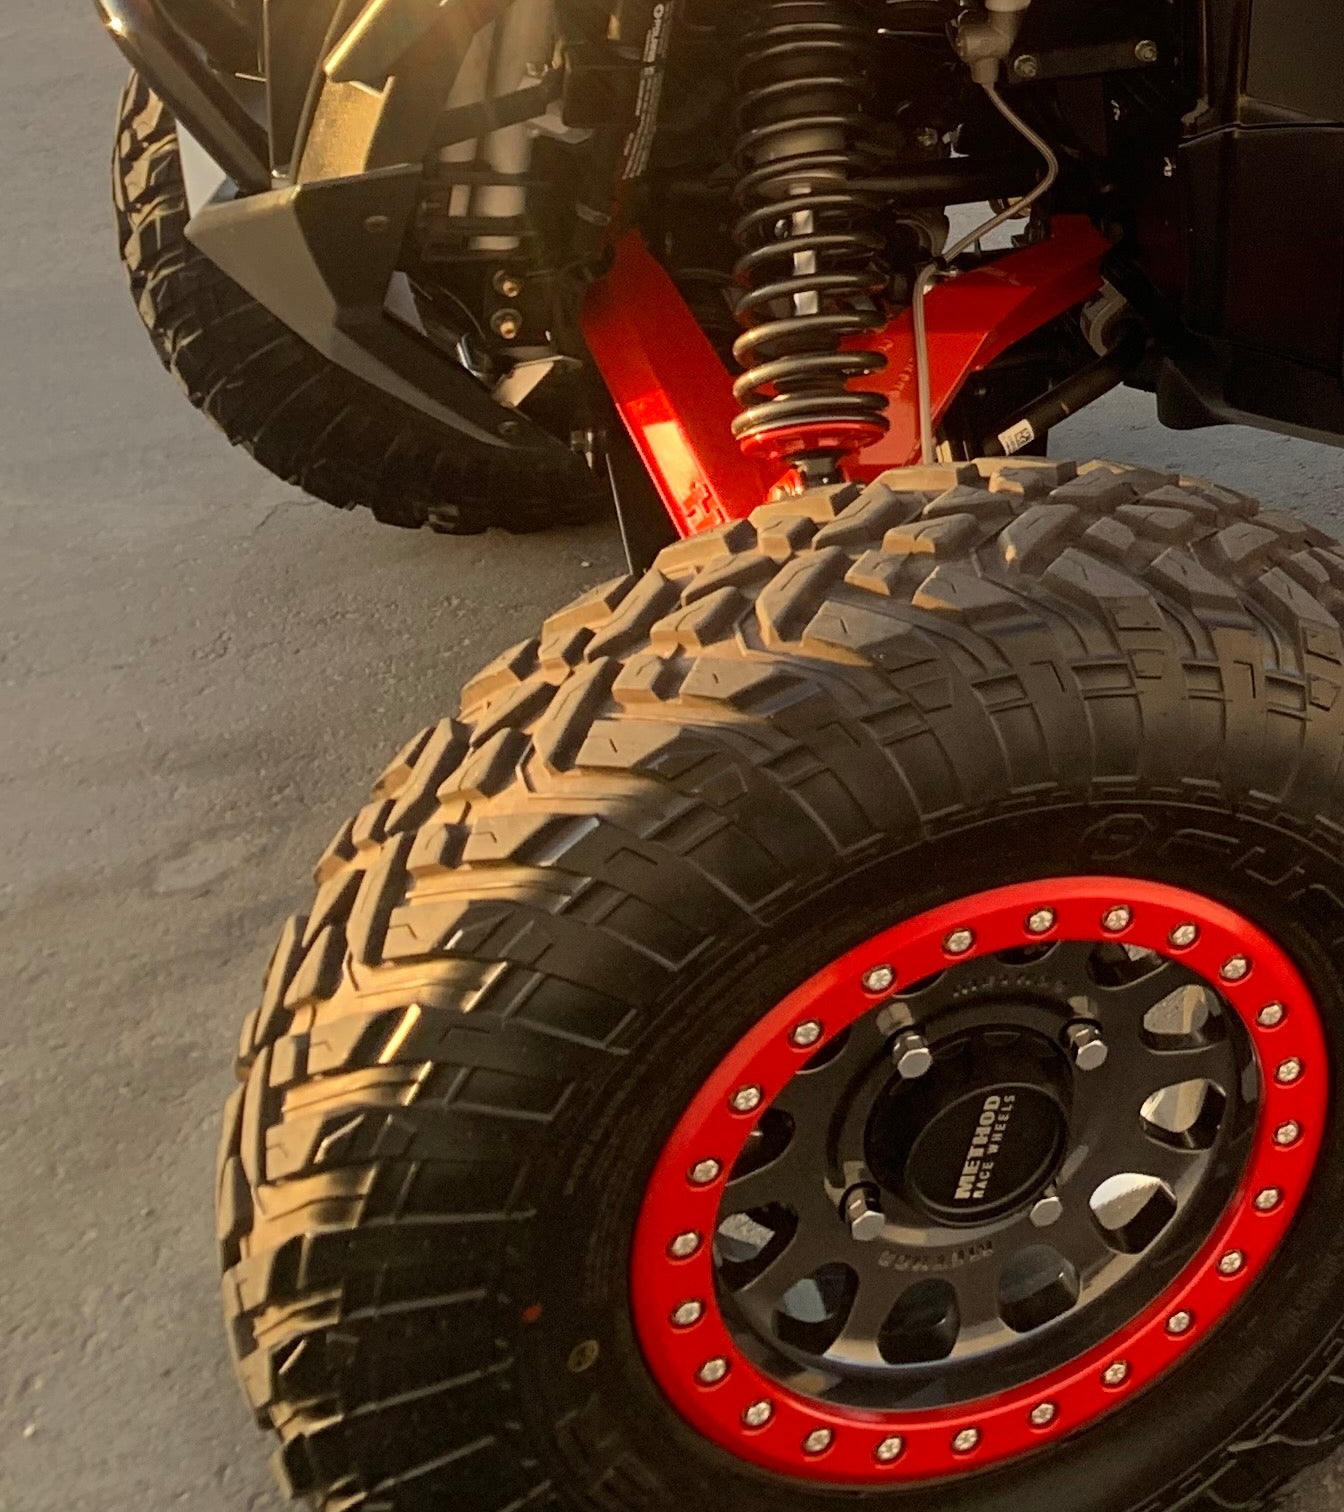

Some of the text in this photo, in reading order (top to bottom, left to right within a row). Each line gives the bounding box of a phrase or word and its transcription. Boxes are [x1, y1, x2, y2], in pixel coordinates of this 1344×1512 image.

[954, 1095, 1001, 1199] METHOD
[972, 1095, 1016, 1199] RACE WHEELS
